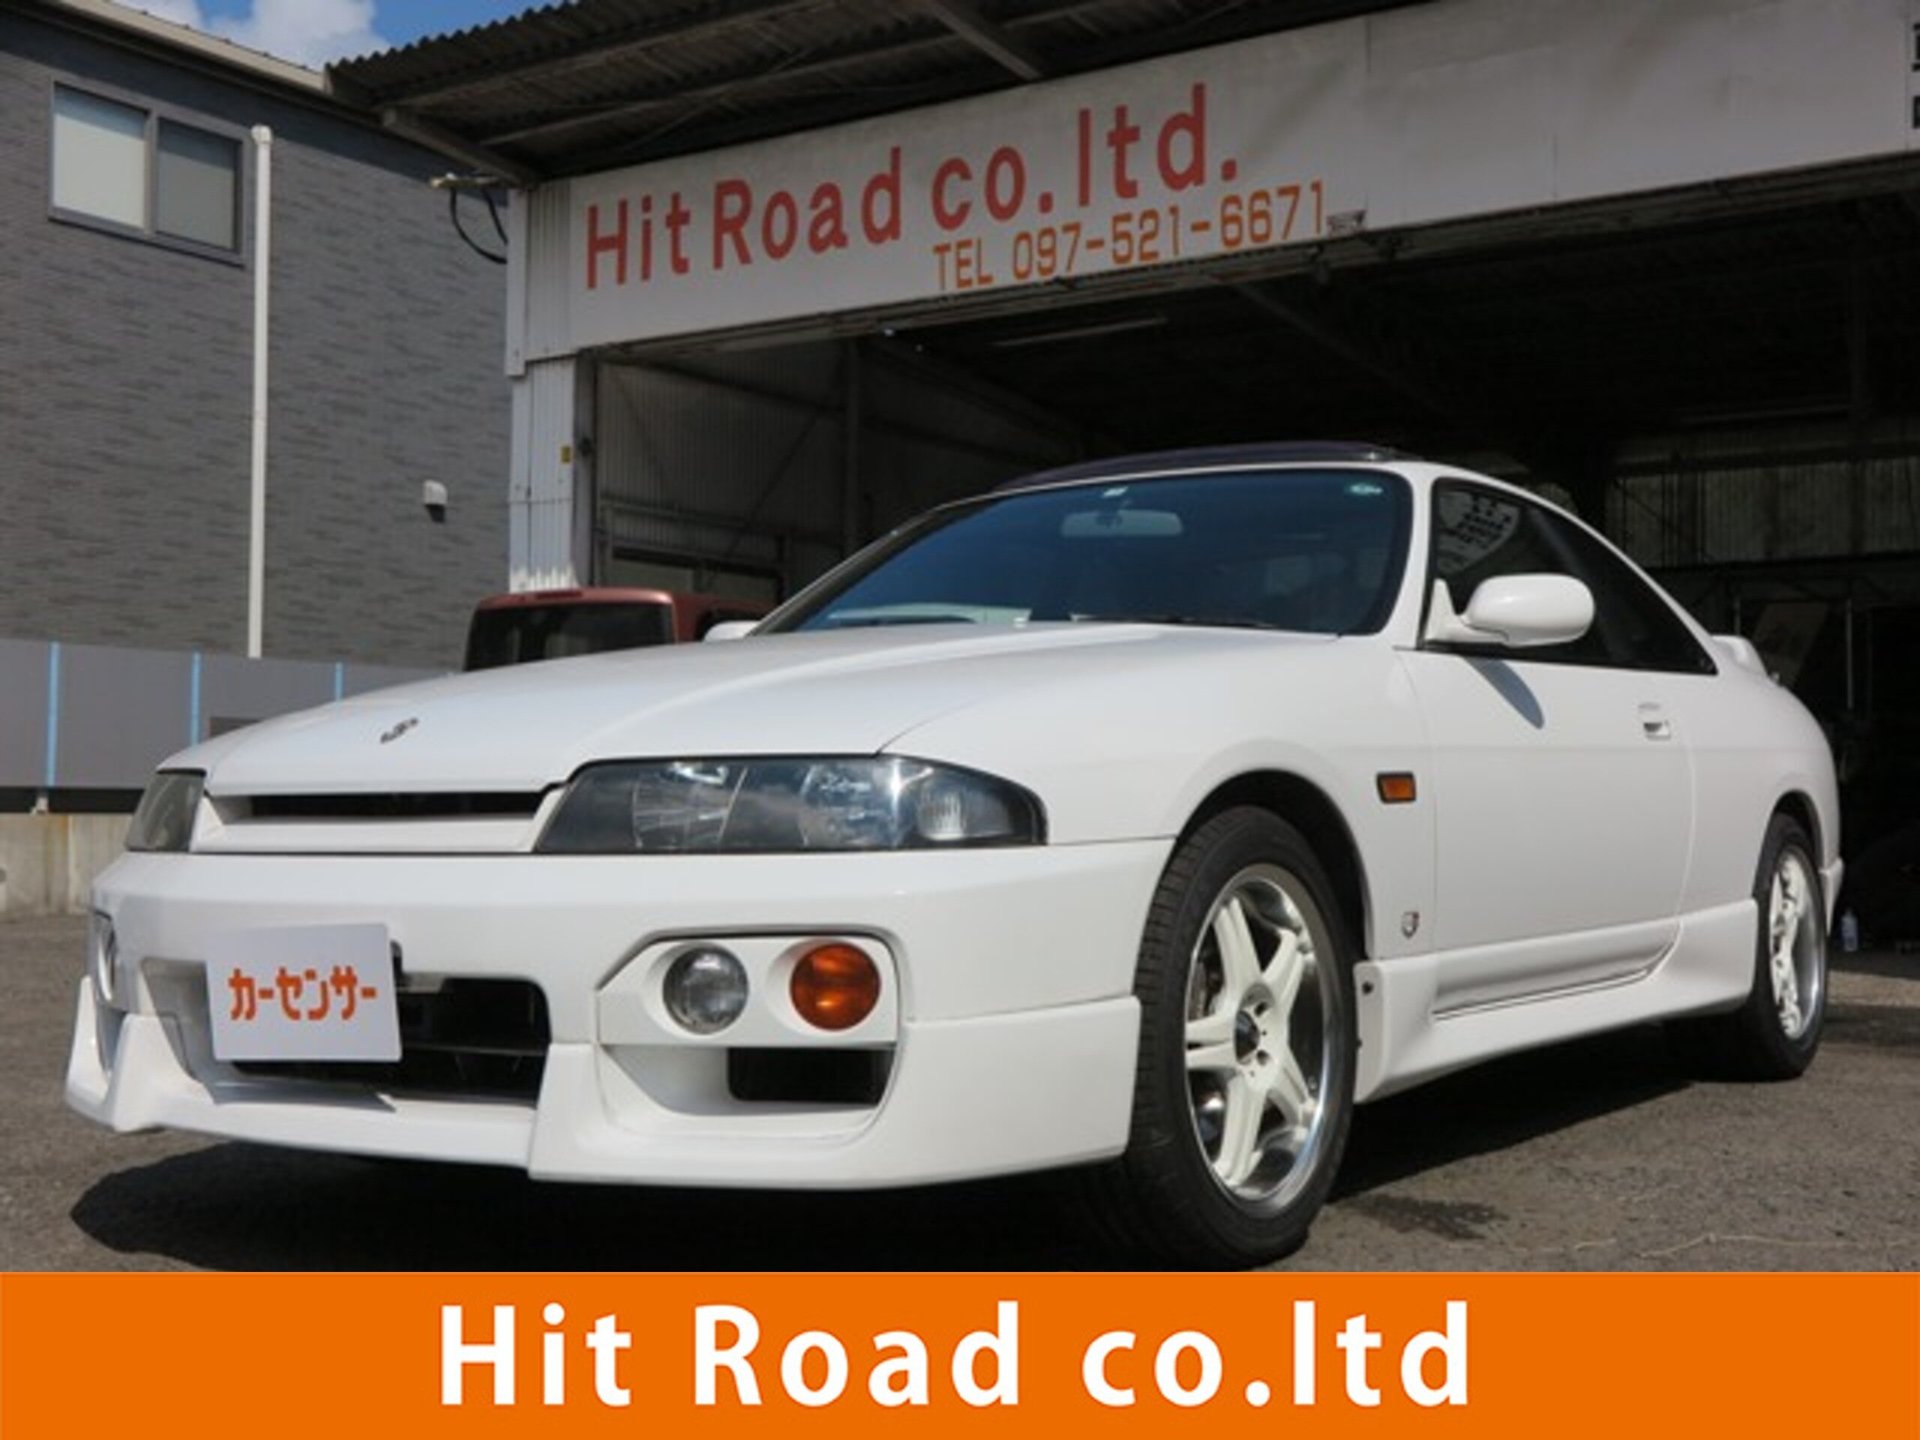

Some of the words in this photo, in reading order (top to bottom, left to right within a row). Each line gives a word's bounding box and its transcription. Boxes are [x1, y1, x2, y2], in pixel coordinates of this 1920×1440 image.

[585, 192, 691, 290] Hit
[711, 145, 903, 269] Road
[931, 237, 995, 292] TEL
[1012, 179, 1326, 284] 097-521-6671
[228, 965, 378, 1021] カーセンサー
